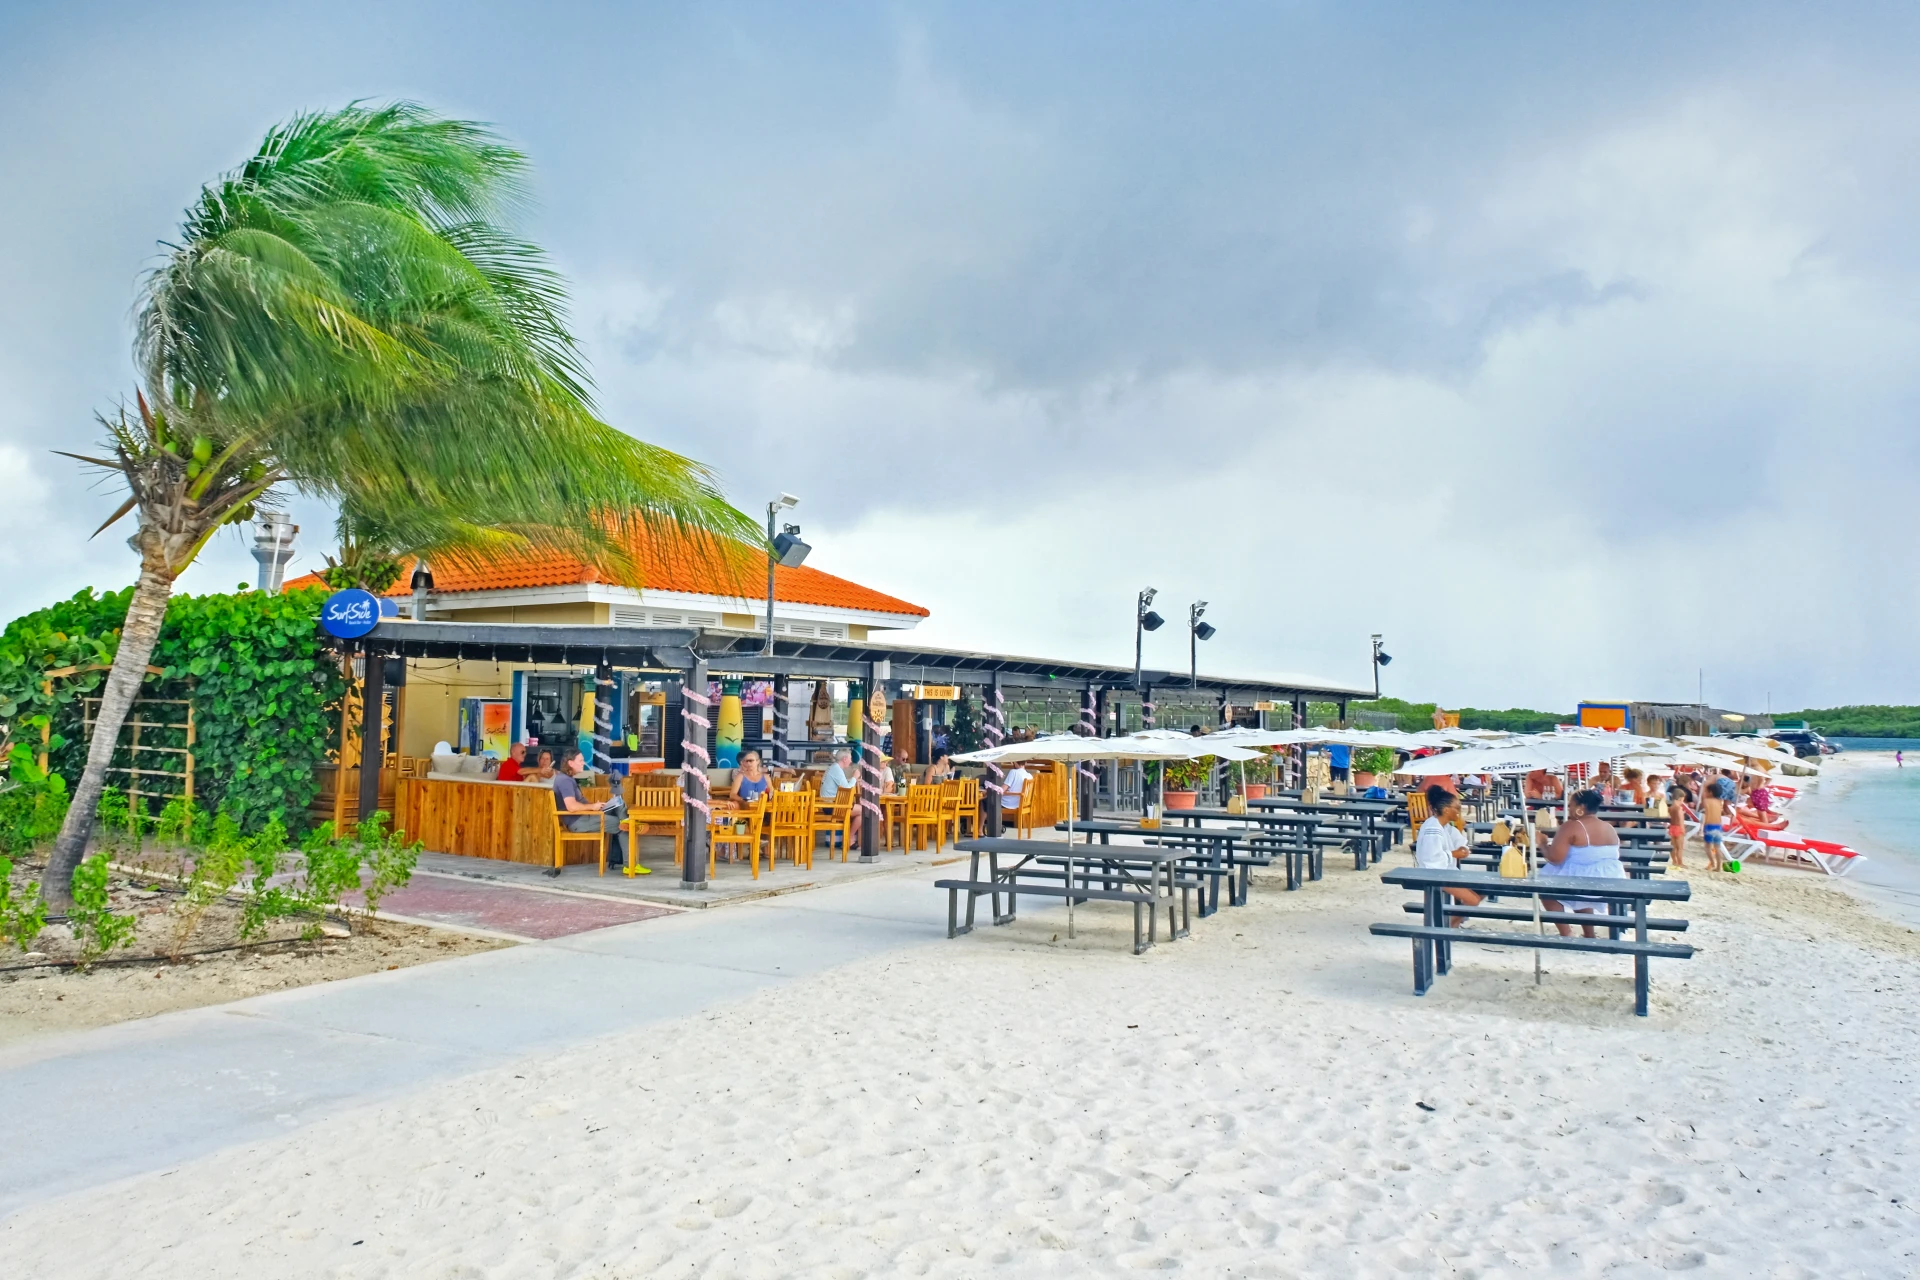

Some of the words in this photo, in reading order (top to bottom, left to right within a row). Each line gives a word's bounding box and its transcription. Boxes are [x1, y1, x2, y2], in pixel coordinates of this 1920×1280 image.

[327, 601, 372, 624] SurfSide
[924, 689, 933, 697] THIS
[934, 689, 939, 697] IS
[1480, 763, 1534, 772] Corona
